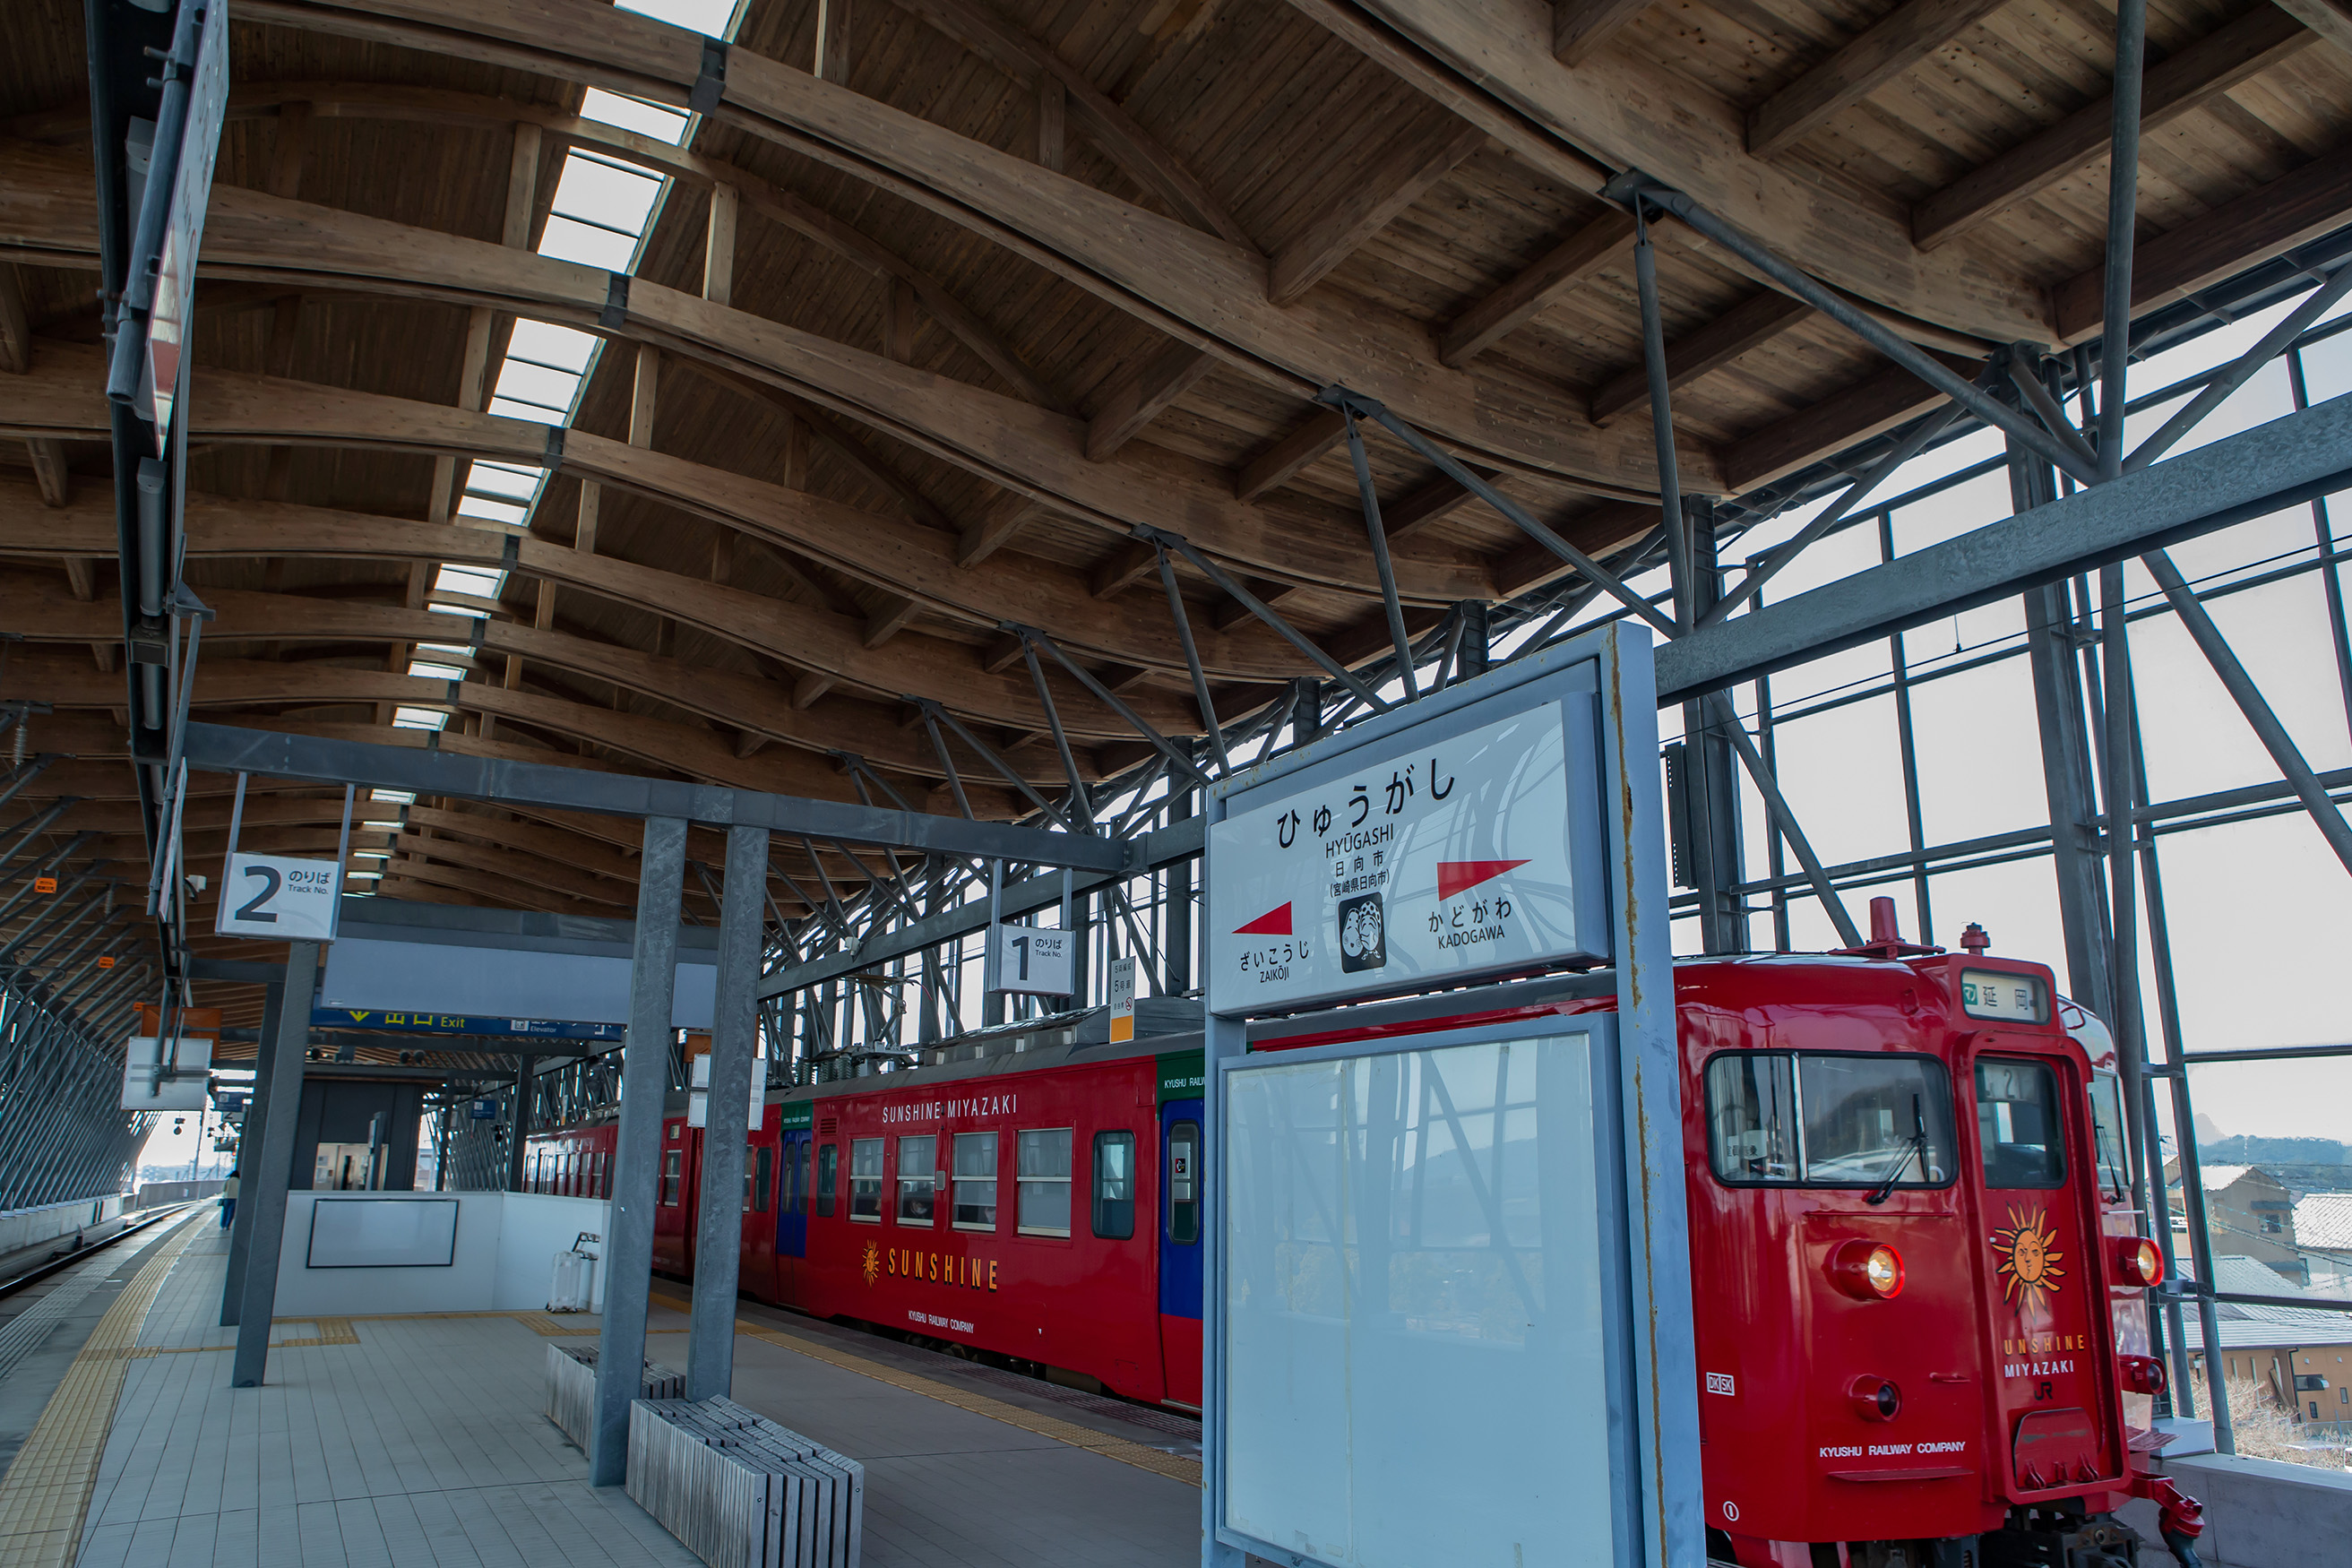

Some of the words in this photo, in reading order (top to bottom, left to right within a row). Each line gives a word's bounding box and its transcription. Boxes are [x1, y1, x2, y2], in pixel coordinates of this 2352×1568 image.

[1277, 758, 1455, 849] ひゅうがし
[1326, 823, 1393, 858] HYŪGASHI
[1336, 850, 1383, 877] 日向市
[288, 884, 312, 894] Track
[314, 886, 329, 895] No.
[289, 871, 331, 884] のりば
[1331, 868, 1390, 898] (宮崎県日向市)
[235, 866, 282, 923] 2
[1428, 897, 1512, 933] かどがわ
[1035, 938, 1063, 950] のりば
[1438, 925, 1504, 950] KADOGAWA
[1012, 936, 1030, 981] 1
[1035, 950, 1052, 958] Track
[1240, 941, 1309, 971] ざいこうじ
[1260, 965, 1289, 983] ZAIKŌJI
[1983, 986, 2028, 1011] 延岡
[441, 1016, 465, 1029] Exit
[1165, 1078, 1187, 1088] KYUSHU
[883, 1101, 941, 1124] SUNSHINE
[947, 1094, 1017, 1118] MIYAZAKI
[888, 1247, 997, 1291] SUNSHINE
[908, 1310, 926, 1323] KYUSHU
[928, 1314, 948, 1328] RAILWAY
[950, 1318, 974, 1333] COMPANY
[2003, 1334, 2085, 1356] UNSHINE
[2004, 1360, 2074, 1378] MIYAZAKI
[2034, 1382, 2054, 1400] JR
[1820, 1446, 1862, 1457] KYUSHU
[1868, 1443, 1913, 1456] RAILWAY
[1917, 1441, 1966, 1453] COMPANY
